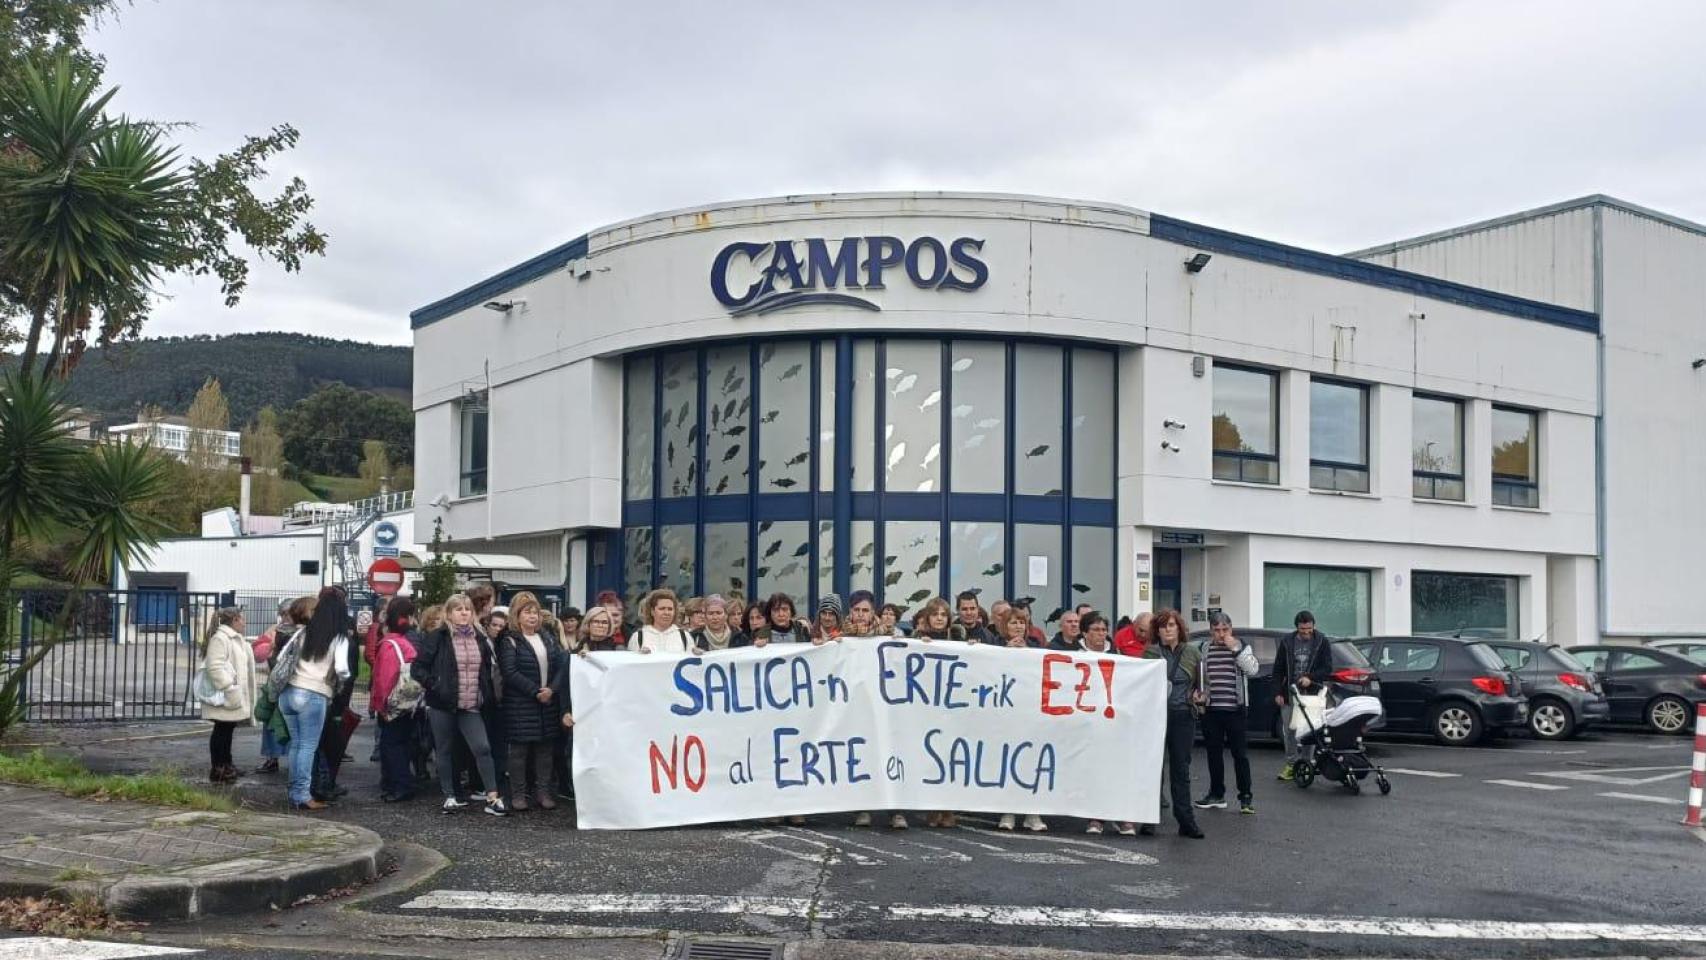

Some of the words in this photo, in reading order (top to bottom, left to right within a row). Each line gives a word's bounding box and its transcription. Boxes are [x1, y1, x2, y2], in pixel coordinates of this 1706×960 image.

[711, 236, 989, 309] CAMPOS
[671, 656, 849, 716] SALICA-n
[877, 641, 1016, 709] ERTE-rik
[648, 733, 707, 794] NO
[729, 737, 754, 785] al
[773, 727, 871, 789] ERTE
[886, 754, 905, 783] en
[922, 728, 1056, 794] SALICA
